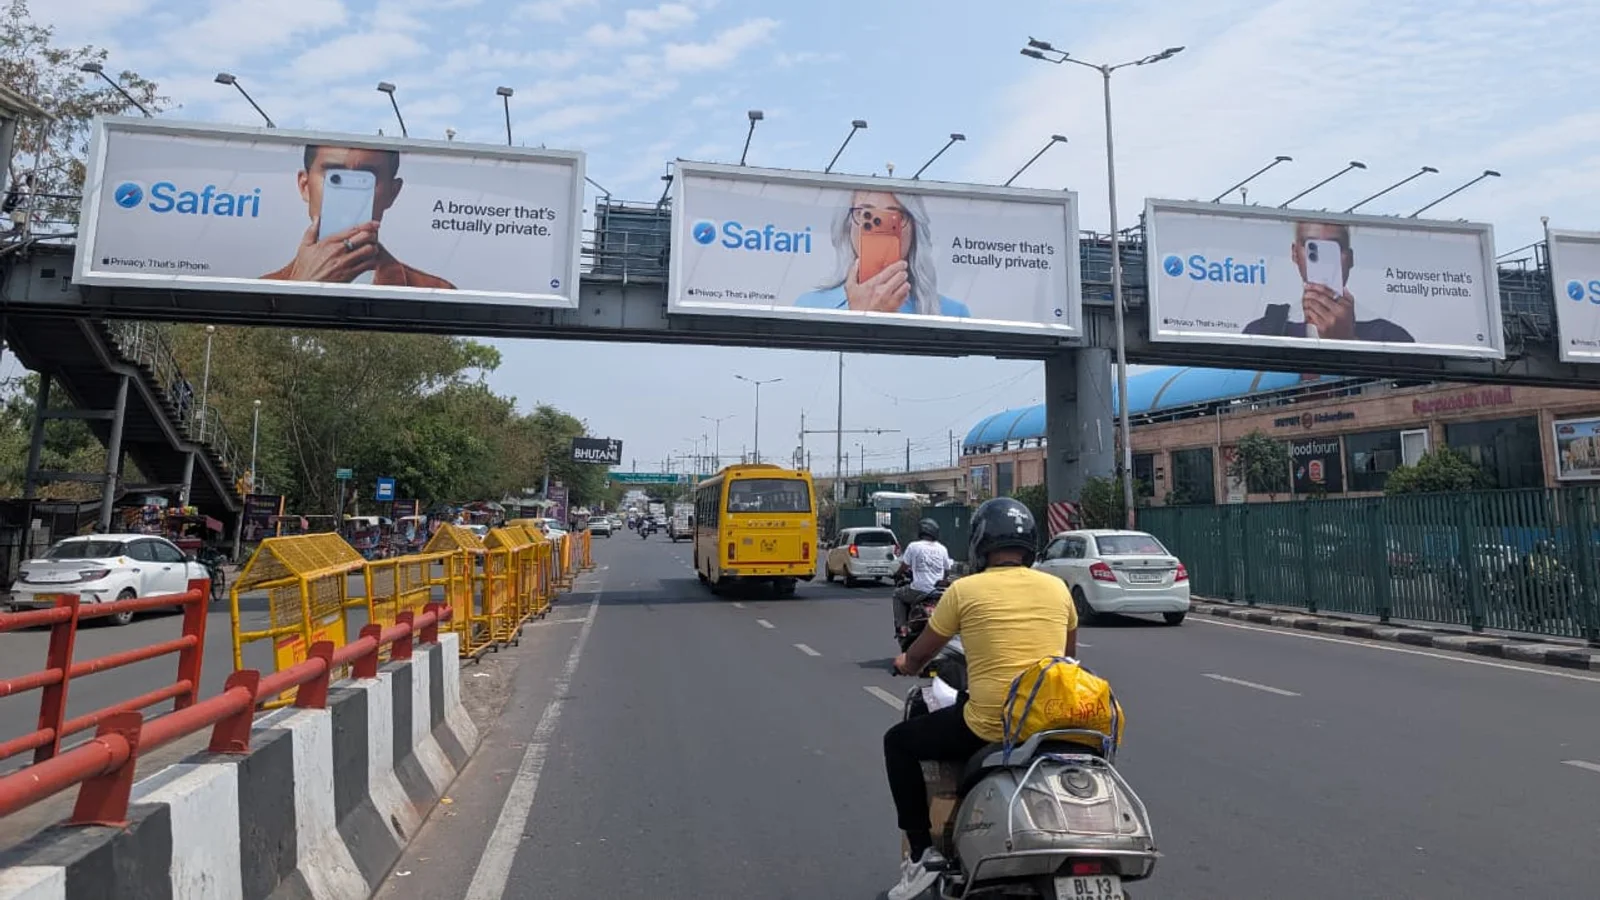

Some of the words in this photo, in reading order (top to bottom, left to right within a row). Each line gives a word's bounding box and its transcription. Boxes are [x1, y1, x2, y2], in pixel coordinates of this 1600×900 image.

[149, 182, 261, 218] Safari
[432, 200, 445, 214] A
[448, 201, 511, 218] browser
[514, 206, 556, 221] that's
[431, 218, 493, 235] actually
[495, 221, 551, 237] private.
[721, 220, 812, 254] Safari
[952, 236, 962, 249] A
[964, 237, 1018, 253] browser
[1019, 241, 1055, 256] that's
[110, 257, 146, 269] Privacy.
[148, 259, 176, 269] That's
[952, 253, 1003, 269] actually
[1004, 256, 1052, 270] private.
[1188, 254, 1266, 285] Safari
[1386, 267, 1394, 279] A
[1396, 268, 1440, 282] browser
[1442, 271, 1473, 284] that's
[1386, 282, 1429, 297] actually
[1431, 284, 1472, 298] private.
